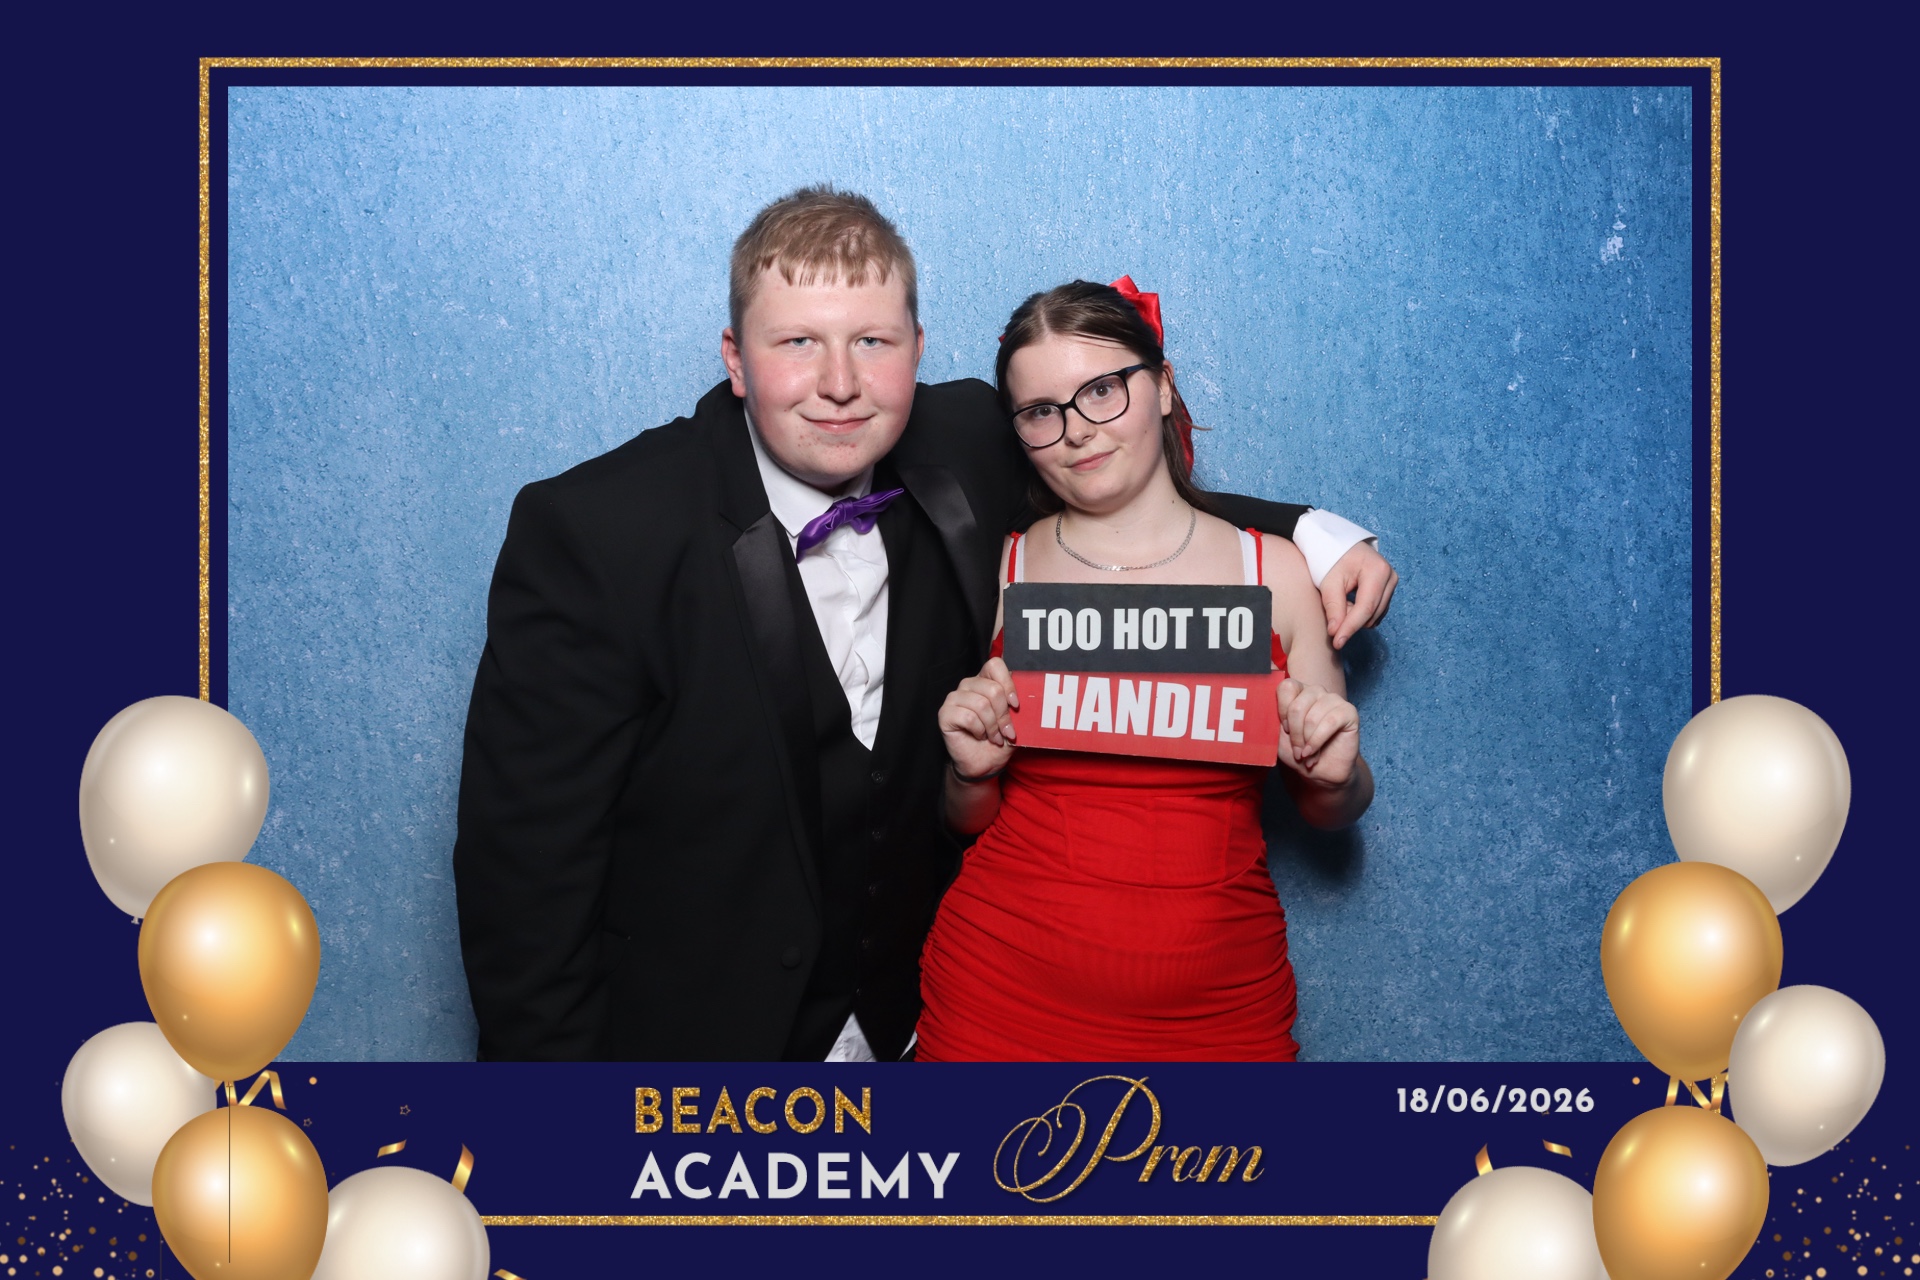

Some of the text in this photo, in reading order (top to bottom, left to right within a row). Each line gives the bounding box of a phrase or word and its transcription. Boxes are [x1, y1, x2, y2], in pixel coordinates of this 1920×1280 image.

[1022, 606, 1254, 651] TOO HOT TO
[1041, 673, 1248, 743] HANDLE
